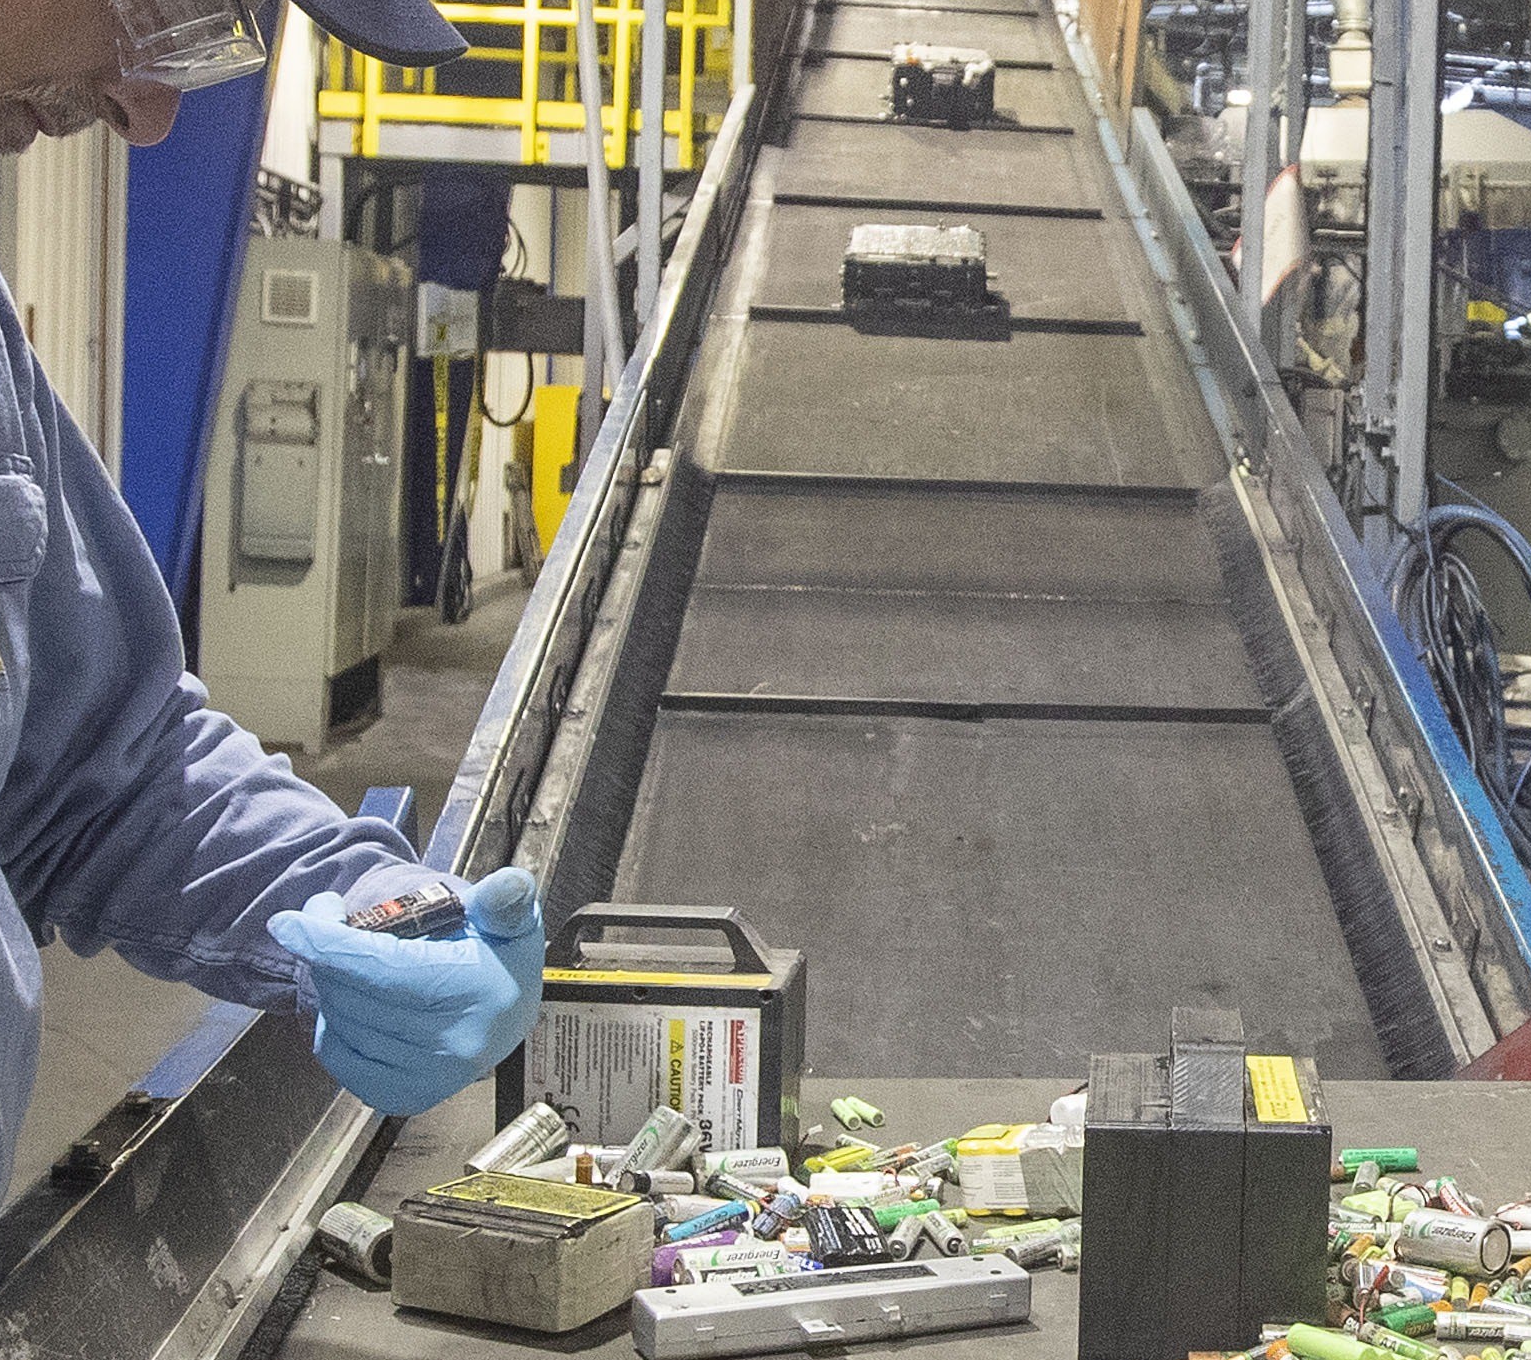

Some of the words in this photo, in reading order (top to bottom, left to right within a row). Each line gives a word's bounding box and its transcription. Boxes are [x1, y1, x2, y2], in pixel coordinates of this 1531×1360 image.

[705, 1020, 714, 1086] RECHARGEABLE
[698, 1055, 707, 1092] BATTERY
[697, 1095, 706, 1115] PACK
[732, 1156, 781, 1171] Energizer
[1430, 1225, 1477, 1244] Energizer
[725, 1249, 781, 1263] Energizer
